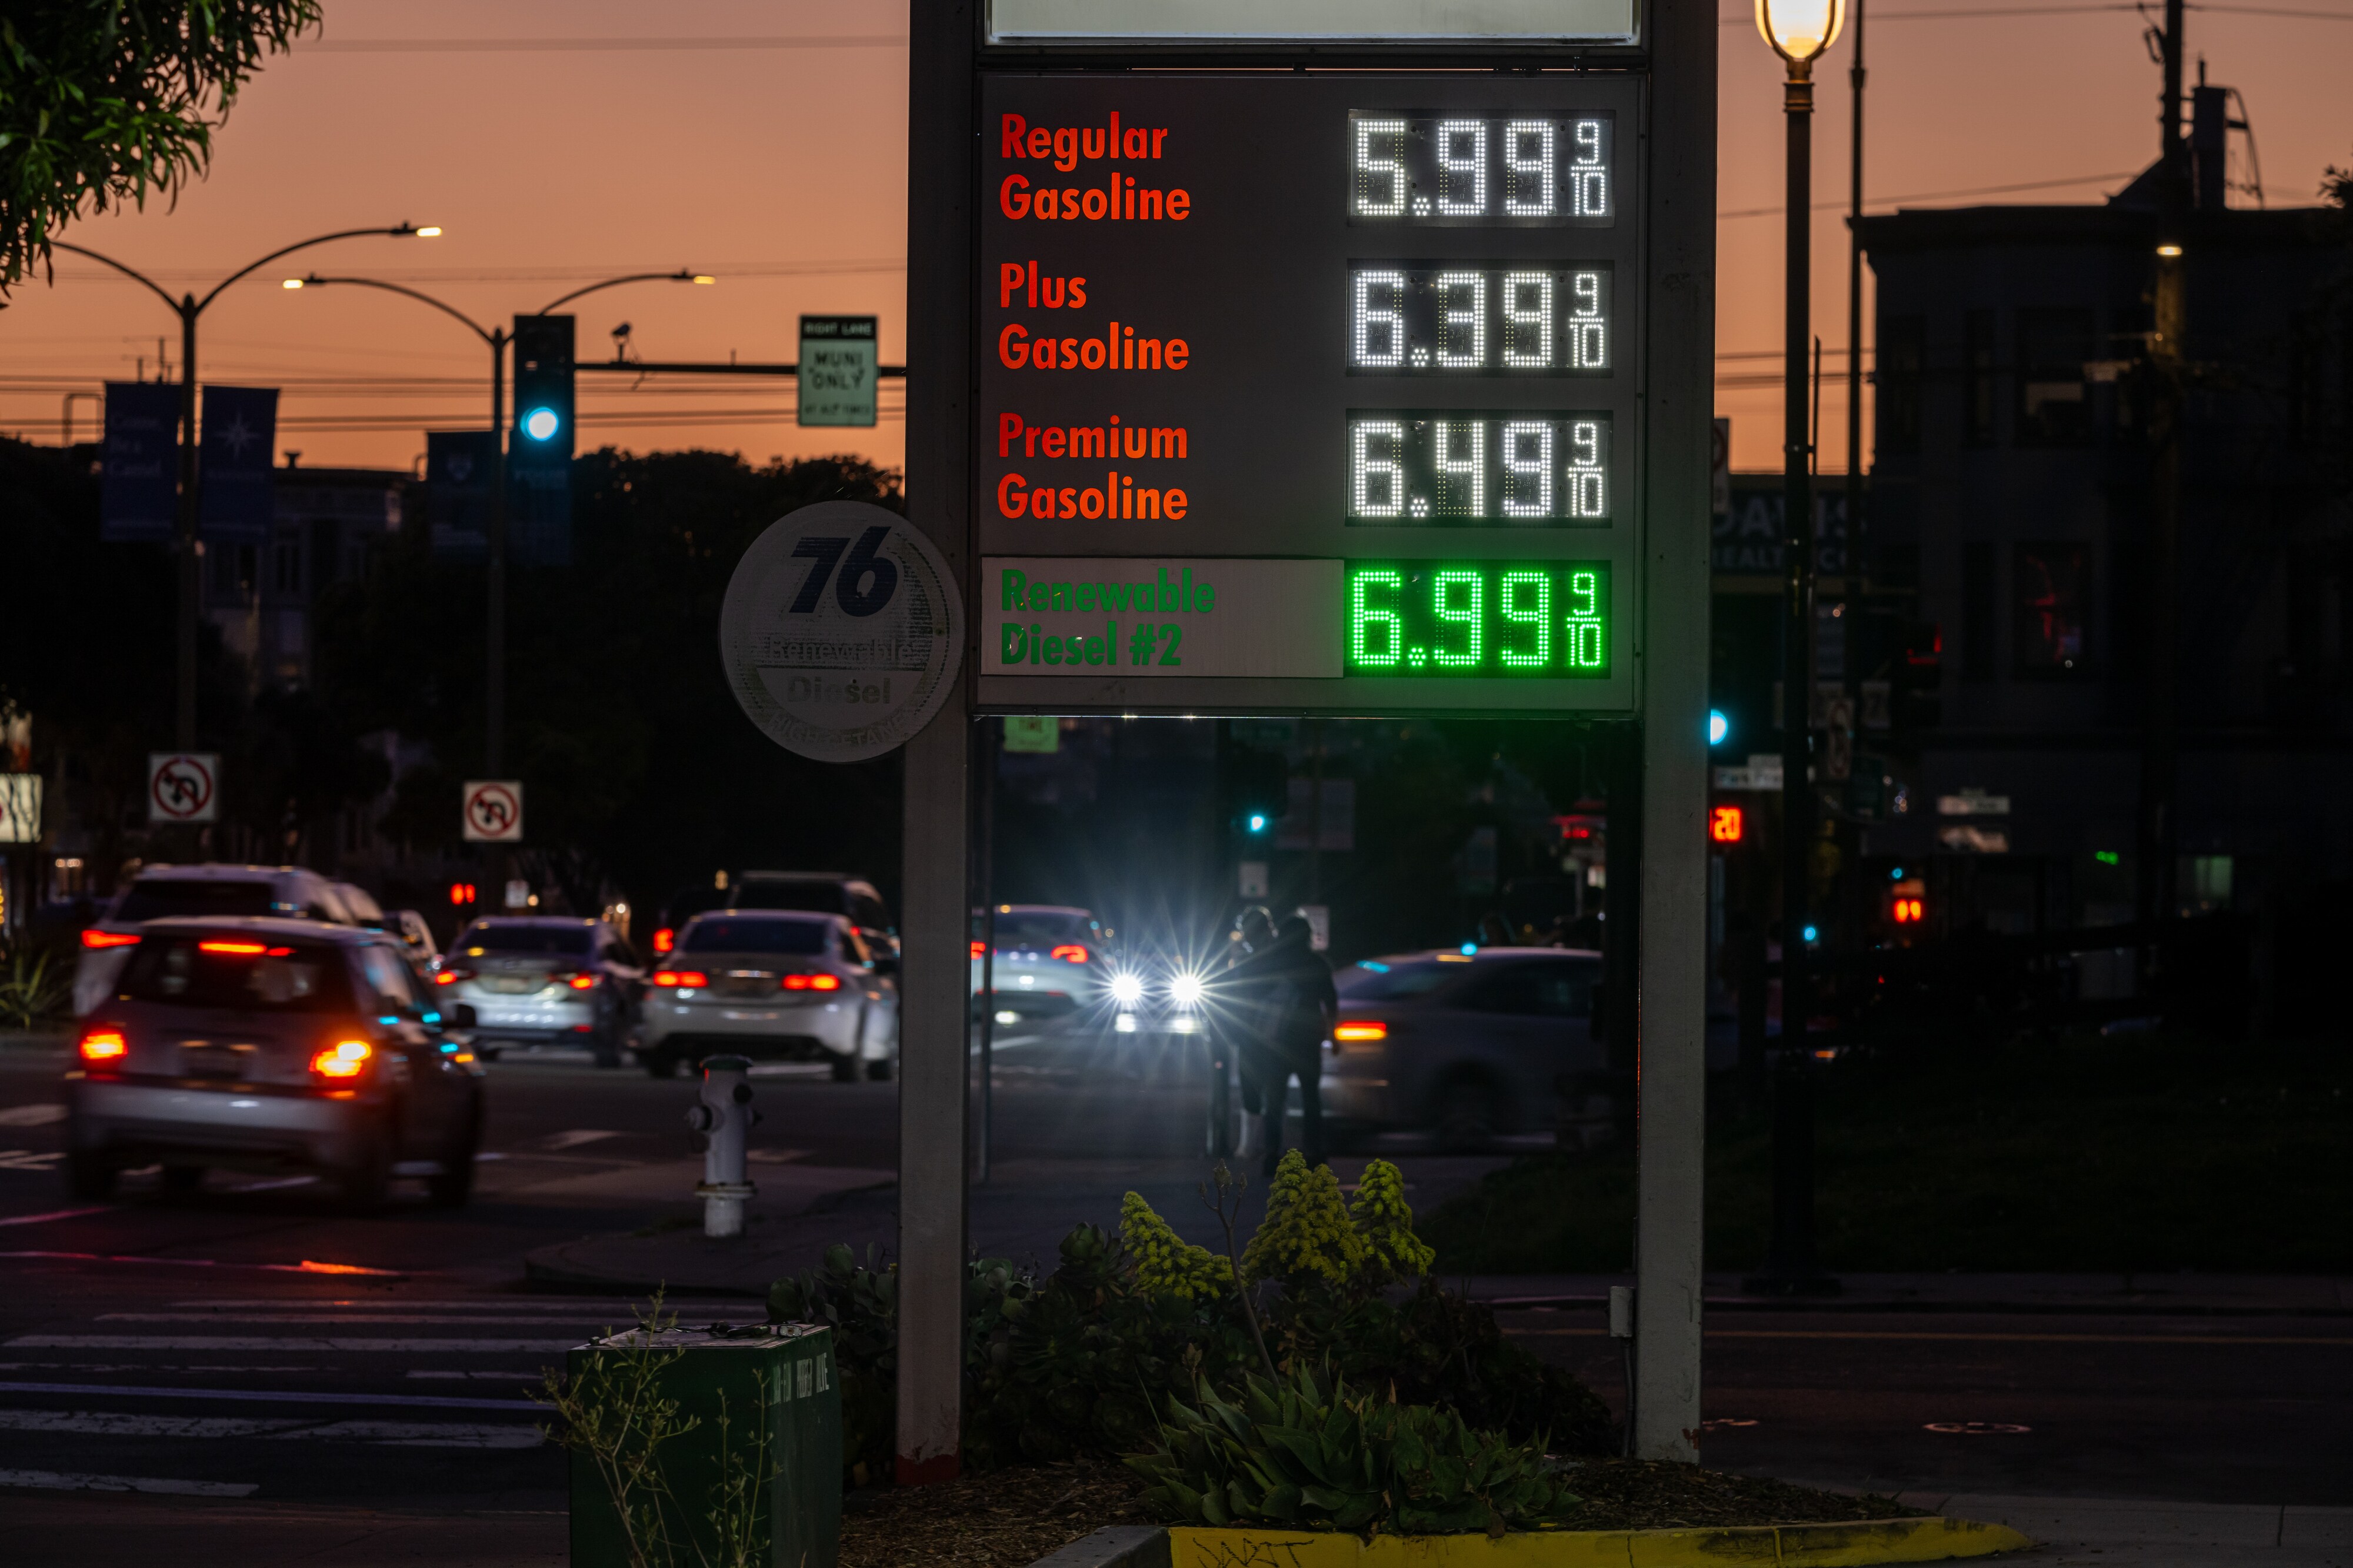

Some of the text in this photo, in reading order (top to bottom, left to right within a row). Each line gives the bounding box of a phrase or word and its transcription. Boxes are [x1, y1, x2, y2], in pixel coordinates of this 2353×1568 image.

[1002, 112, 1167, 171] Regular
[1358, 121, 1554, 216] 5.99
[1000, 173, 1190, 220] Gasoline
[1001, 261, 1086, 308] Plus
[1356, 271, 1552, 367] 6.39
[999, 322, 1189, 370] Gasoline
[811, 373, 863, 389] ONLY
[999, 413, 1187, 458] Premium
[1355, 422, 1551, 517] 6.49
[998, 472, 1188, 520] Gasoline
[789, 526, 898, 617] 76
[1002, 568, 1215, 612] Renewable
[1354, 571, 1549, 666] 6.99
[769, 636, 914, 661] Renewable
[1002, 621, 1182, 665] Diesel #2
[787, 676, 891, 704] Diesel
[1714, 806, 1742, 841] 20
